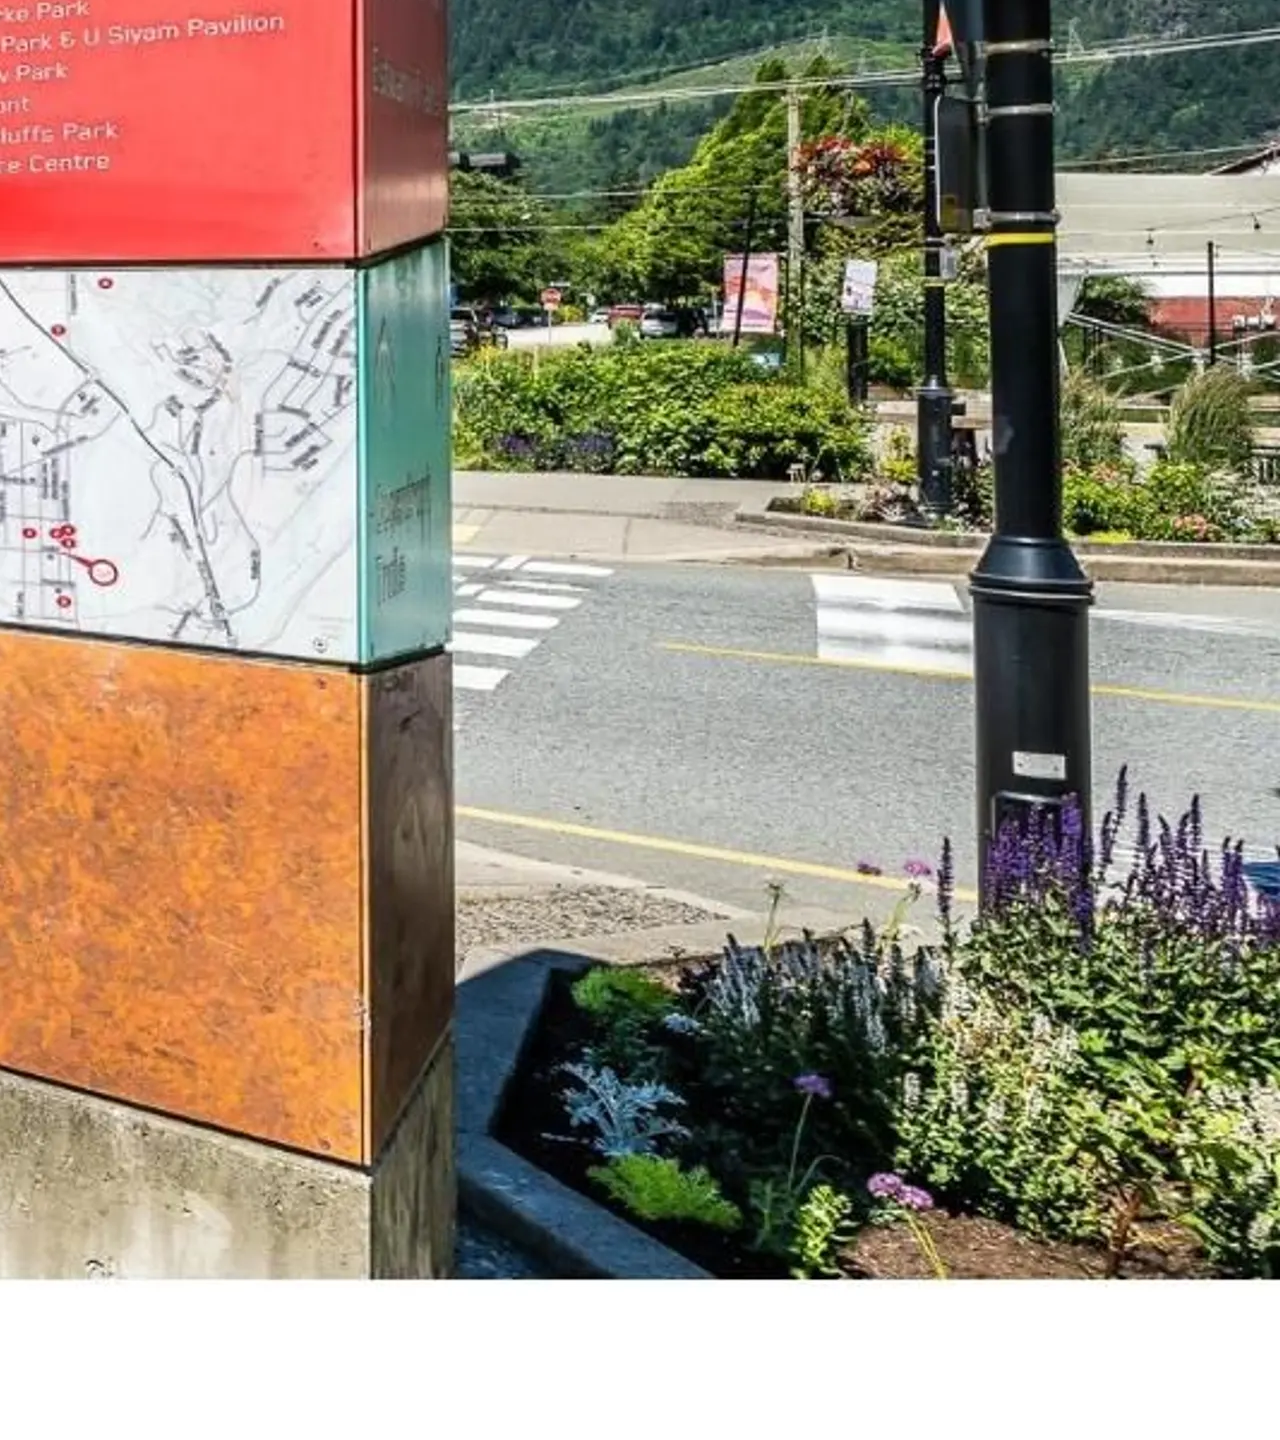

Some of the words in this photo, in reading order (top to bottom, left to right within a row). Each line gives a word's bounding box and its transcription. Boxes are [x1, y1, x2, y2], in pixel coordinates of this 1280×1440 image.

[37, 0, 90, 21] Park
[1, 33, 52, 53] Park
[60, 31, 76, 49] &
[84, 28, 100, 46] U
[108, 24, 180, 46] Siyam
[187, 14, 284, 38] Pavilion
[15, 62, 69, 82] Park
[62, 121, 119, 141] Park
[29, 153, 110, 172] Centre
